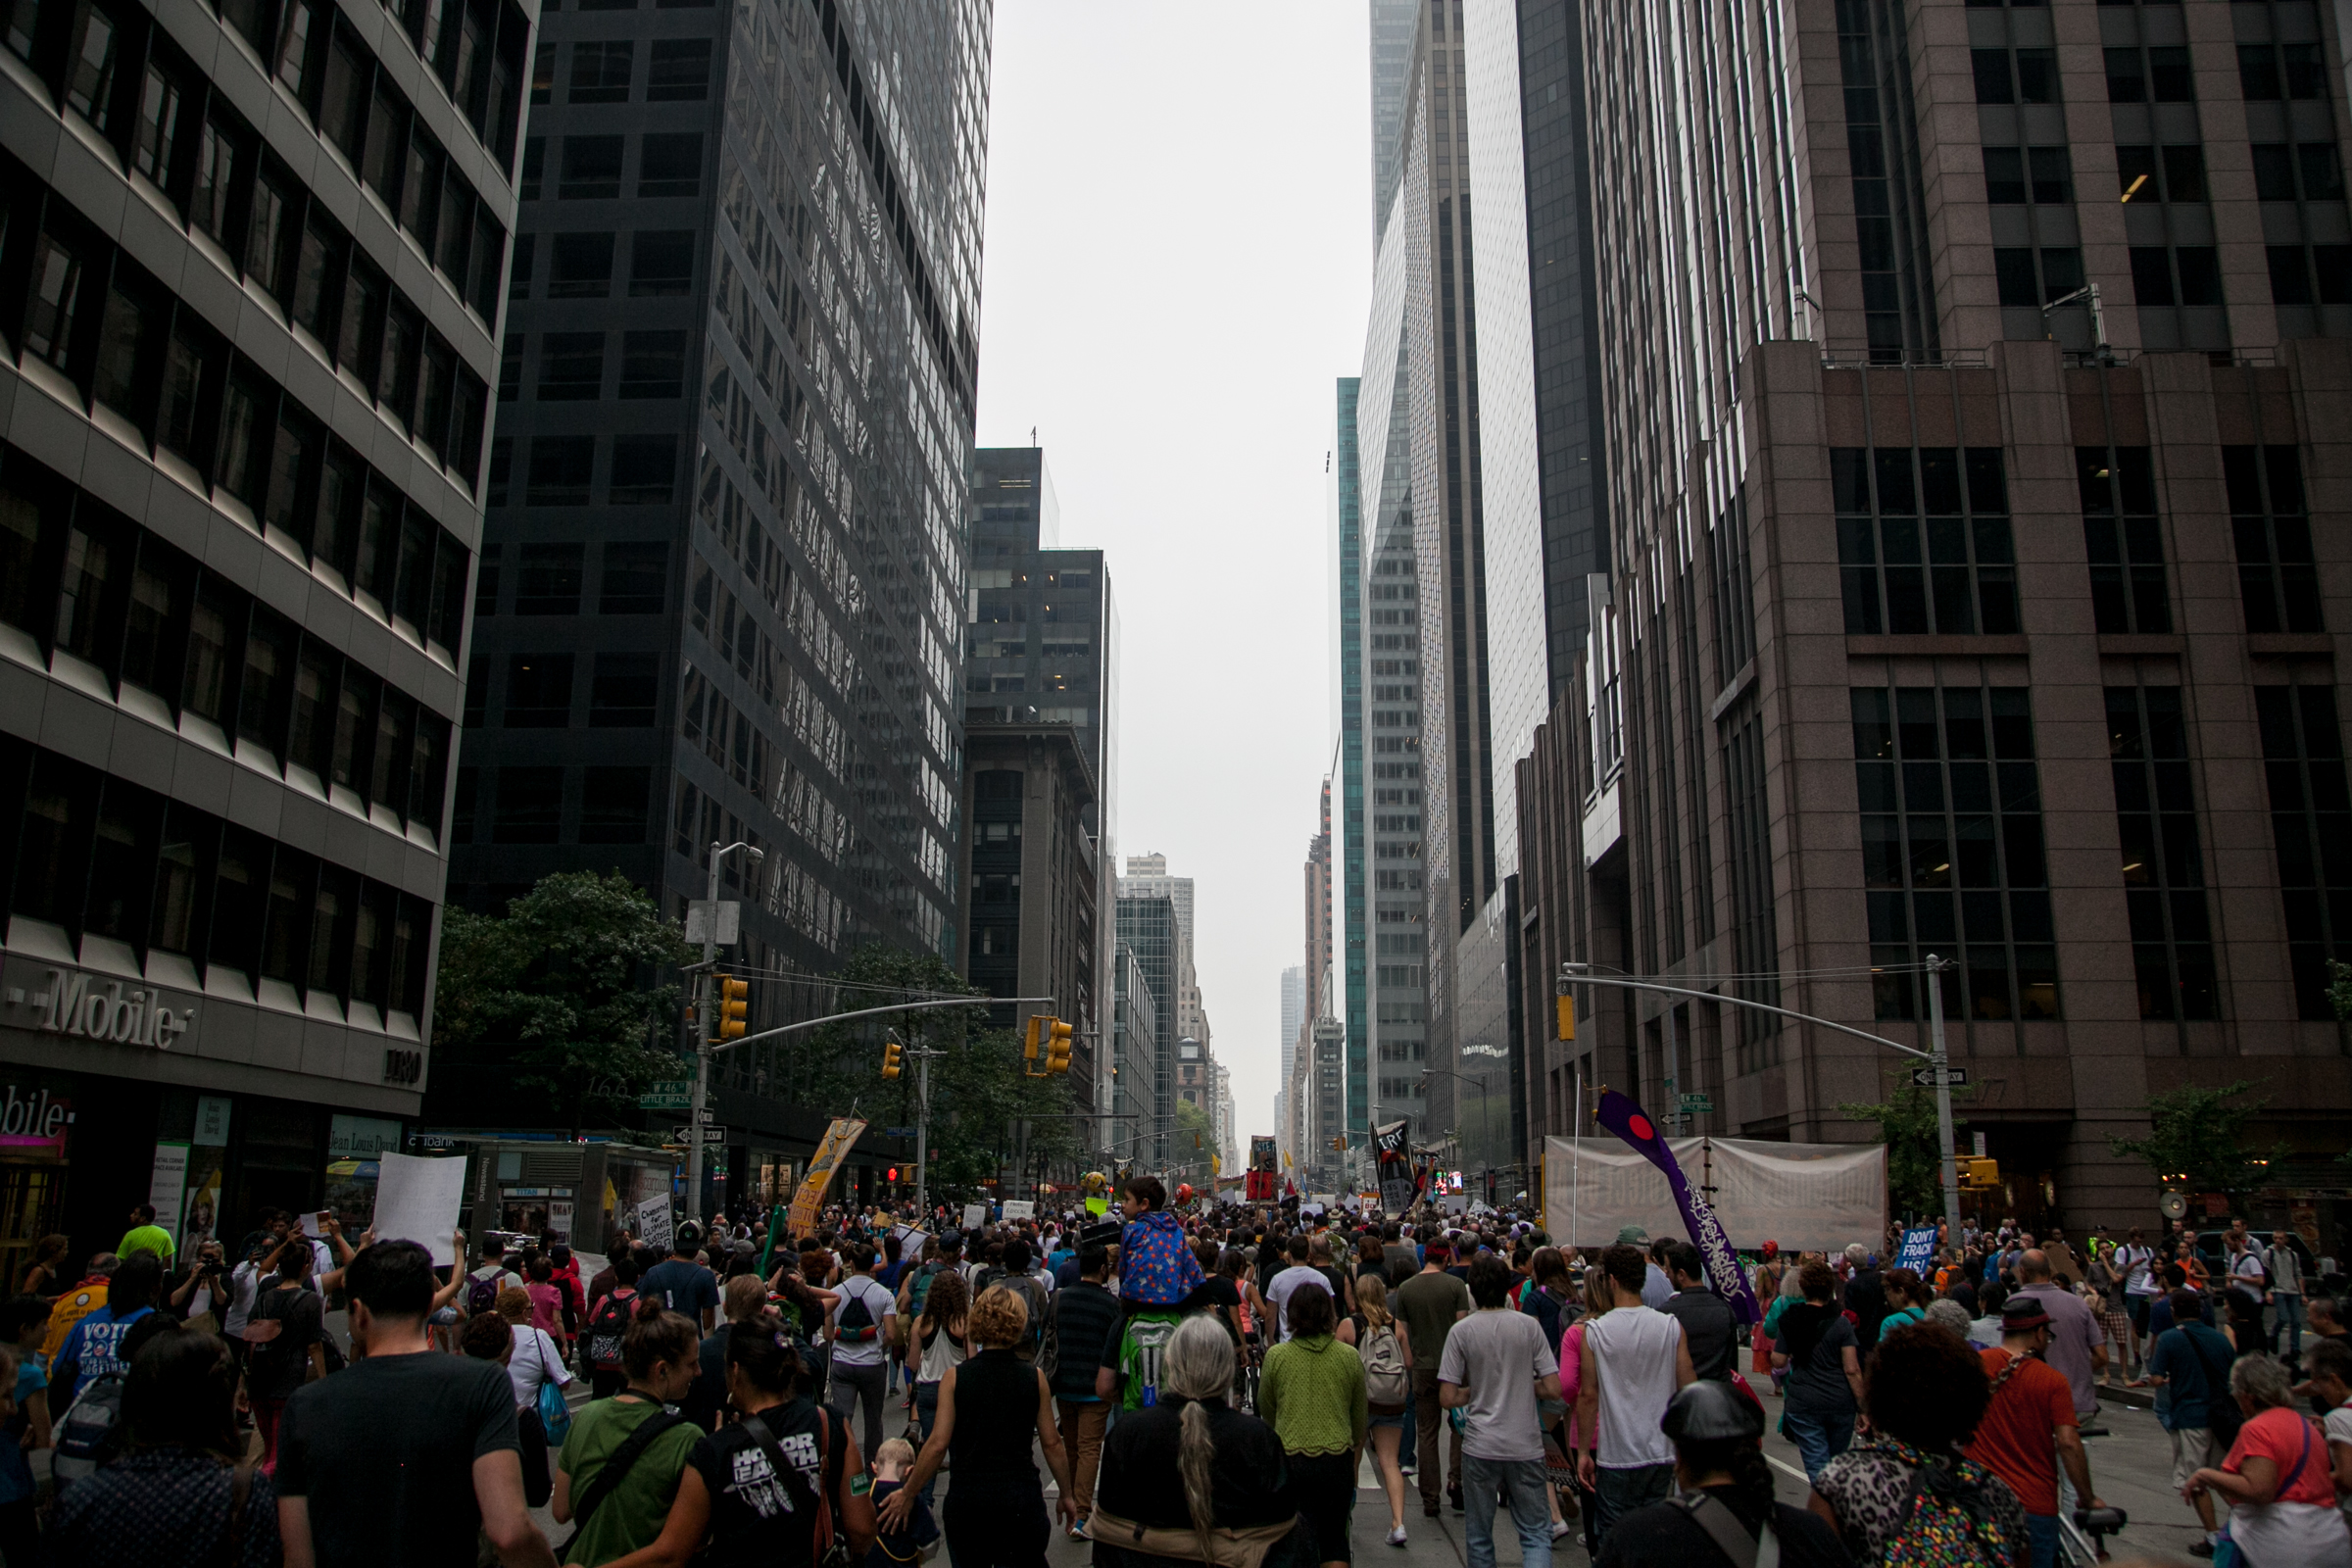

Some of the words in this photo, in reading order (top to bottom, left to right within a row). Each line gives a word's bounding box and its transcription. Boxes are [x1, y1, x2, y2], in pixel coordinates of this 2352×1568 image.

[42, 967, 176, 1050] Mobile
[385, 1049, 421, 1083] 1180
[654, 1083, 661, 1094] W
[664, 1083, 676, 1094] 46
[0, 1085, 65, 1138] bile
[328, 1131, 349, 1150] Jean
[352, 1133, 373, 1152] Louis
[375, 1136, 397, 1152] David
[681, 1130, 691, 1139] ON
[478, 1157, 490, 1201] Newsstand
[643, 1218, 670, 1237] CLIMATE
[651, 1215, 662, 1224] for
[646, 1228, 671, 1248] JUSTICE
[1902, 1242, 1934, 1256] FRACK
[1902, 1259, 1926, 1273] US!
[732, 1432, 815, 1468] HOOR
[734, 1446, 819, 1485] EATH
